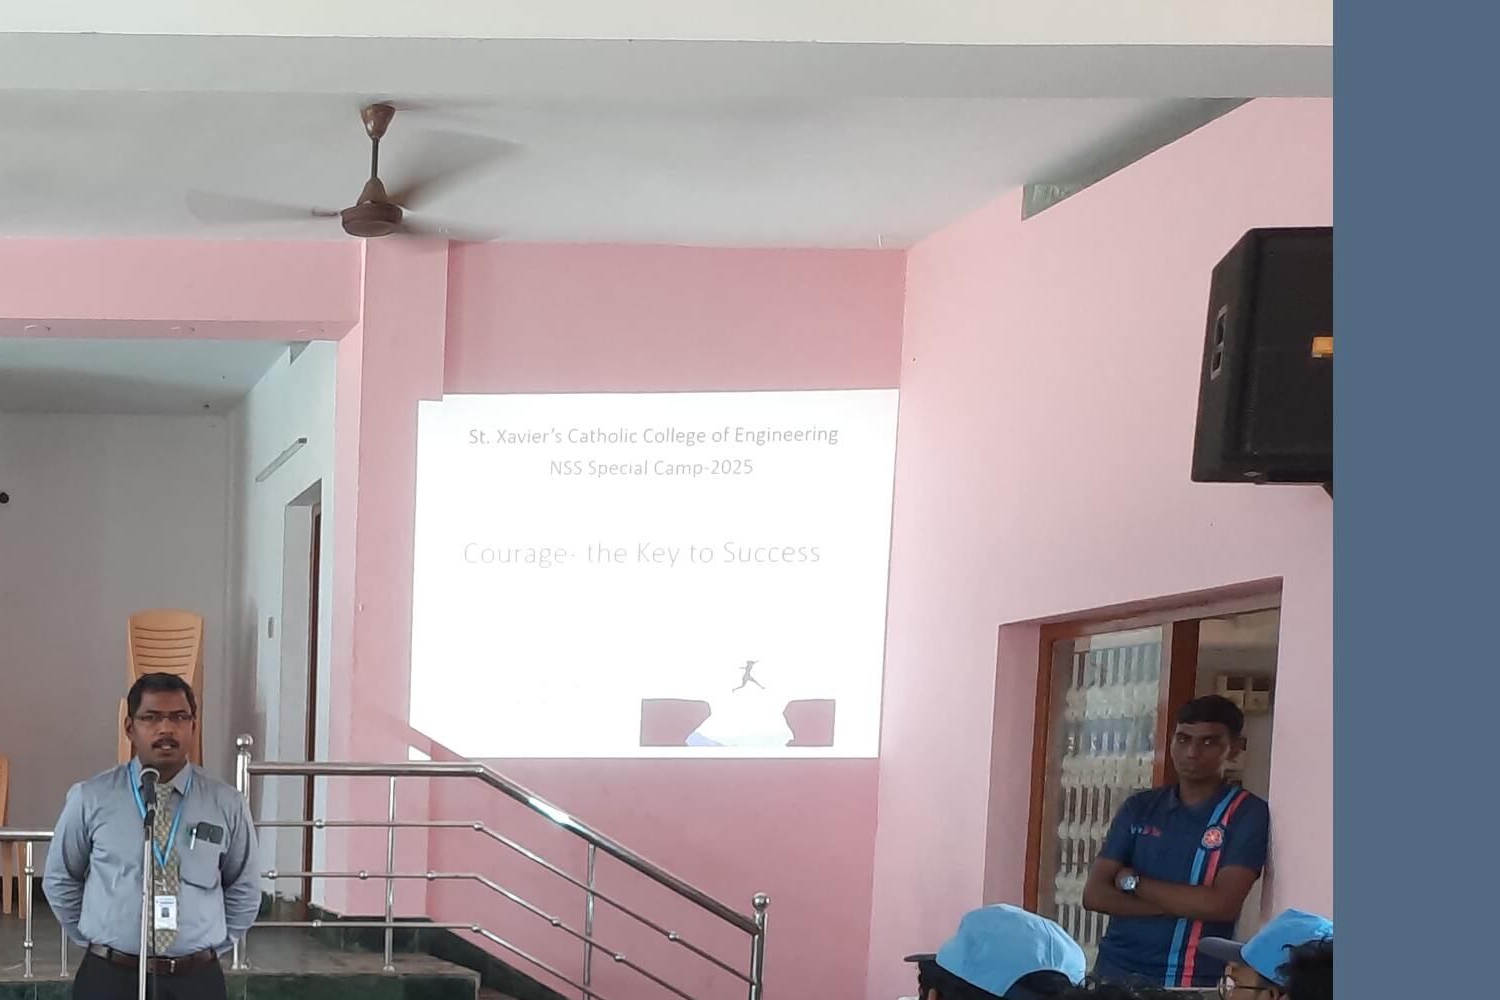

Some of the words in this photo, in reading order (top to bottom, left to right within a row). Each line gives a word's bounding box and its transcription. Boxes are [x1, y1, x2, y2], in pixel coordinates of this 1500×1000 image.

[469, 428, 490, 445] St.
[497, 427, 562, 444] Xavier's
[568, 427, 637, 444] Catholic
[643, 427, 706, 447] College
[711, 426, 730, 443] of
[735, 427, 839, 447] Engineering
[550, 460, 582, 476] NSS
[588, 459, 648, 479] Special
[654, 459, 753, 478] Camp-2025
[463, 541, 576, 569] Courage-
[588, 541, 628, 564] the
[637, 542, 680, 568] Key
[690, 544, 714, 564] to
[723, 541, 821, 564] Success
